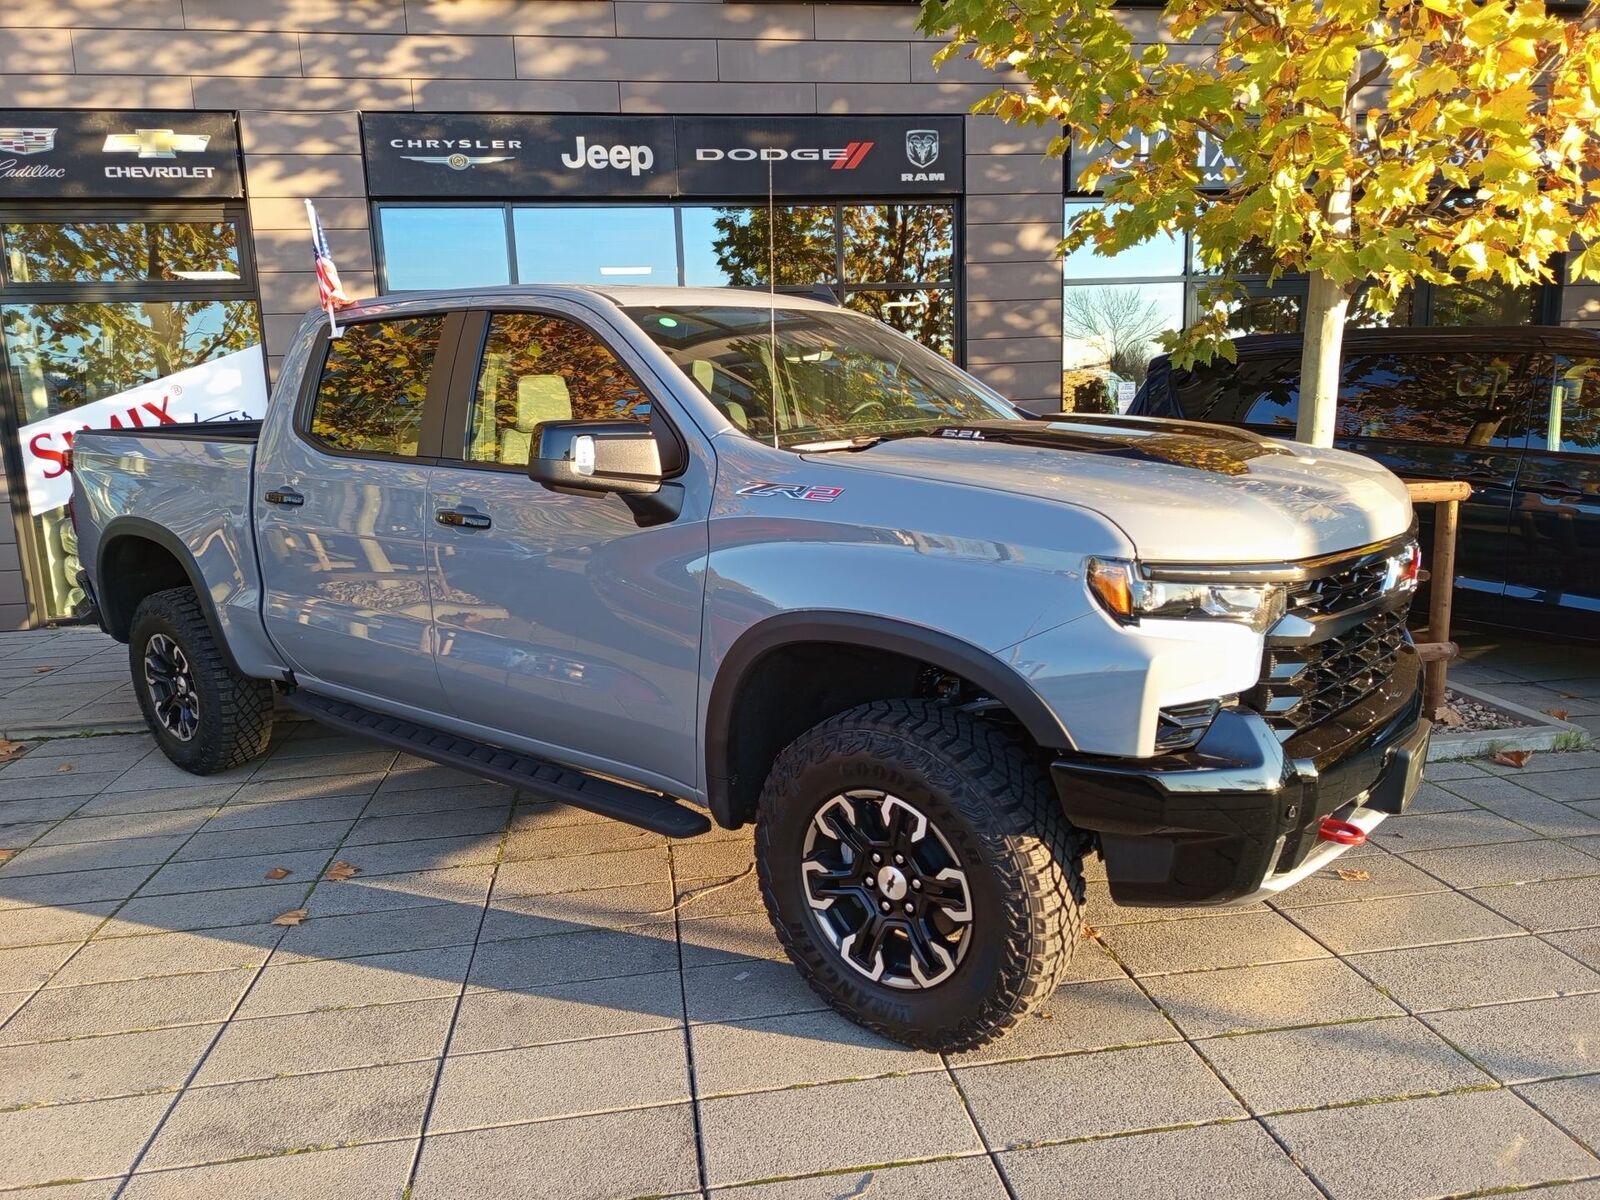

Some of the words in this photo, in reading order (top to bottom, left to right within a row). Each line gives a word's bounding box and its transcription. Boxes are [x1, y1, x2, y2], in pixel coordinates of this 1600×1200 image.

[390, 138, 522, 149] CHRYSLER
[561, 136, 654, 176] Jeep
[696, 148, 849, 161] DODGE
[104, 166, 215, 179] CHEVROLET
[901, 172, 945, 181] RAM
[735, 481, 846, 503] ZR2
